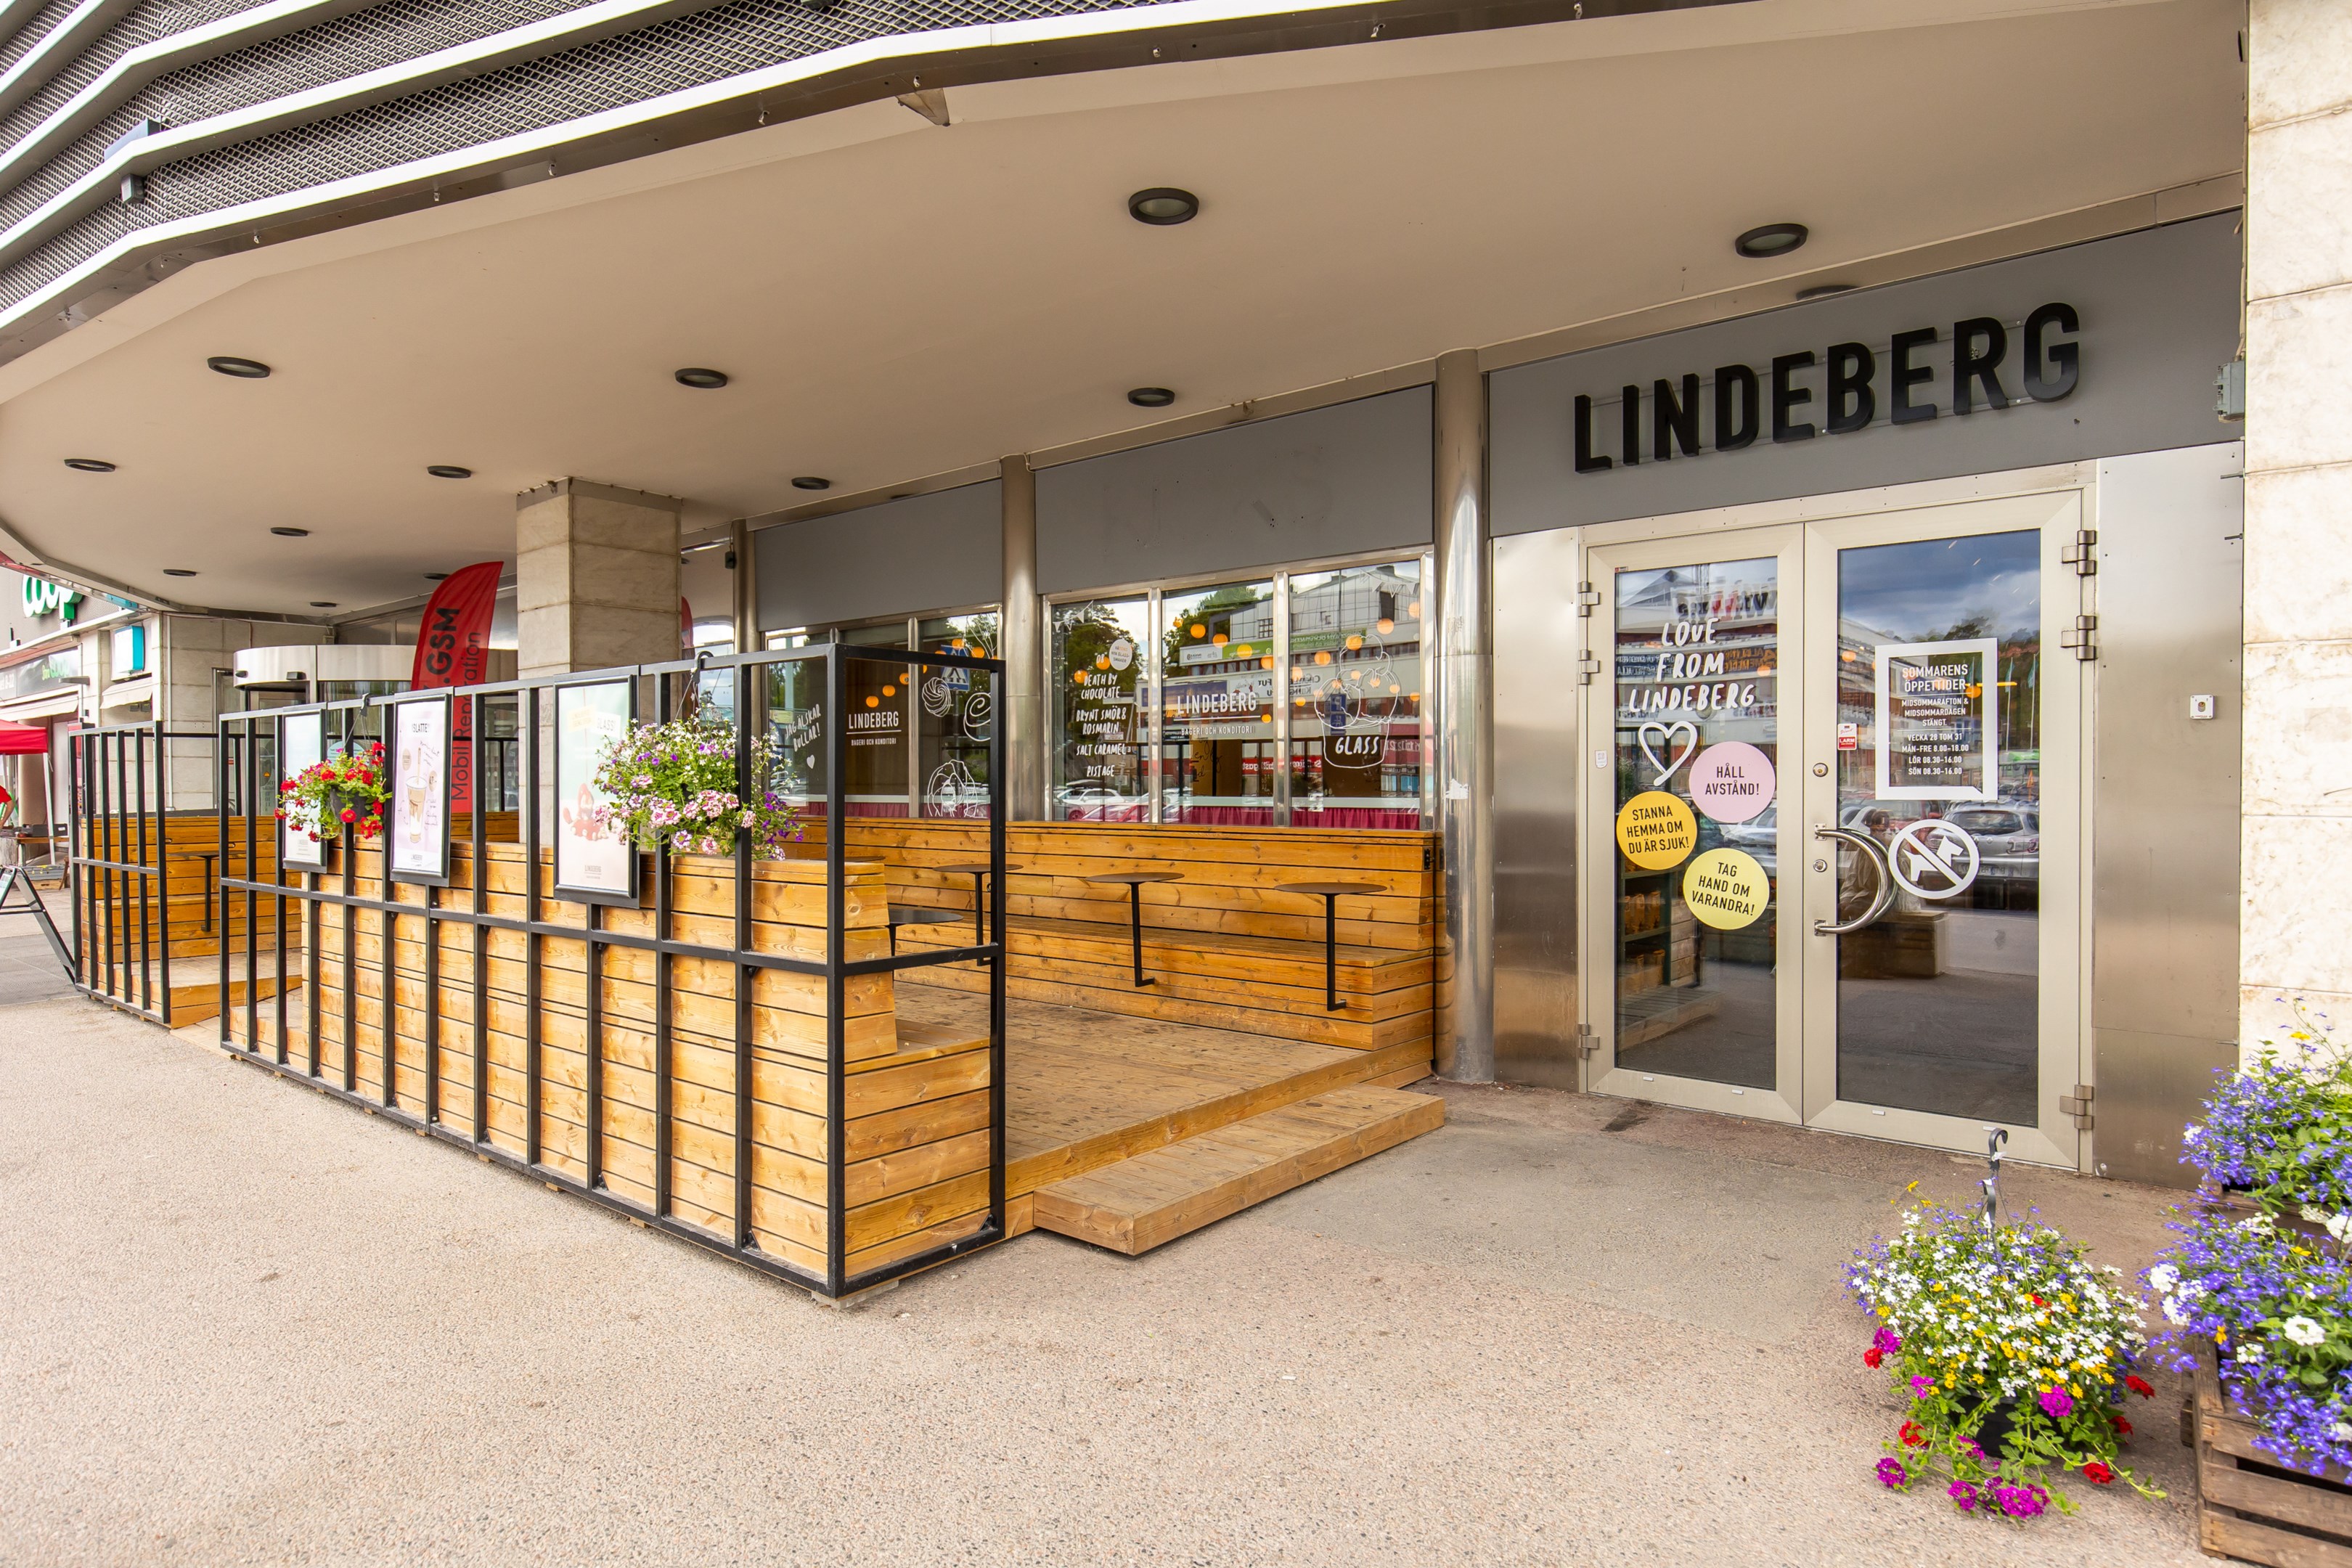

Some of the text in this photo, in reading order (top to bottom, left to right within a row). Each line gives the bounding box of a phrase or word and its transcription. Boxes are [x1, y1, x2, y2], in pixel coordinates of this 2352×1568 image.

[1575, 302, 2080, 474] LINDEBERG
[1662, 618, 1719, 647] LOVE
[1657, 652, 1724, 682] FROM
[1902, 664, 1968, 678] SOMMARENS
[1084, 673, 1117, 686] DEATH BY
[1905, 679, 1966, 692] ÖPPETTIDER
[1081, 686, 1120, 700] CHOCOLATE
[1629, 682, 1755, 713] LINDEBERG
[1177, 691, 1257, 714] LINDEBERG
[1901, 698, 1961, 706] MIDSOMMARAFTON
[452, 632, 481, 800] Mobil Repation
[1076, 709, 1099, 722] BRYNT
[1904, 708, 1966, 716] MIDSOMMARDAGEN
[785, 703, 821, 739] JAG ÄLSKAR
[848, 711, 899, 730] LINDEBERG
[1082, 722, 1119, 735] ROSMARIN
[793, 722, 820, 752] BULLAR!
[1181, 727, 1202, 736] BAGERI
[1219, 725, 1252, 734] KONDITORI
[1077, 743, 1127, 756] SALT CARAMEL
[1335, 736, 1379, 755] GLASS
[1086, 764, 1115, 777] PISTAGE
[1716, 763, 1744, 778] HÅLL
[1705, 780, 1760, 796] AVSTÅND!
[1632, 805, 1673, 821] STANNA
[1626, 820, 1683, 838] HEMMA OM
[1628, 836, 1690, 854] DU ÄR SJUK!
[1718, 862, 1737, 877] TAG
[1699, 875, 1750, 897] HAND OM
[1692, 890, 1755, 916] VARANDRA!
